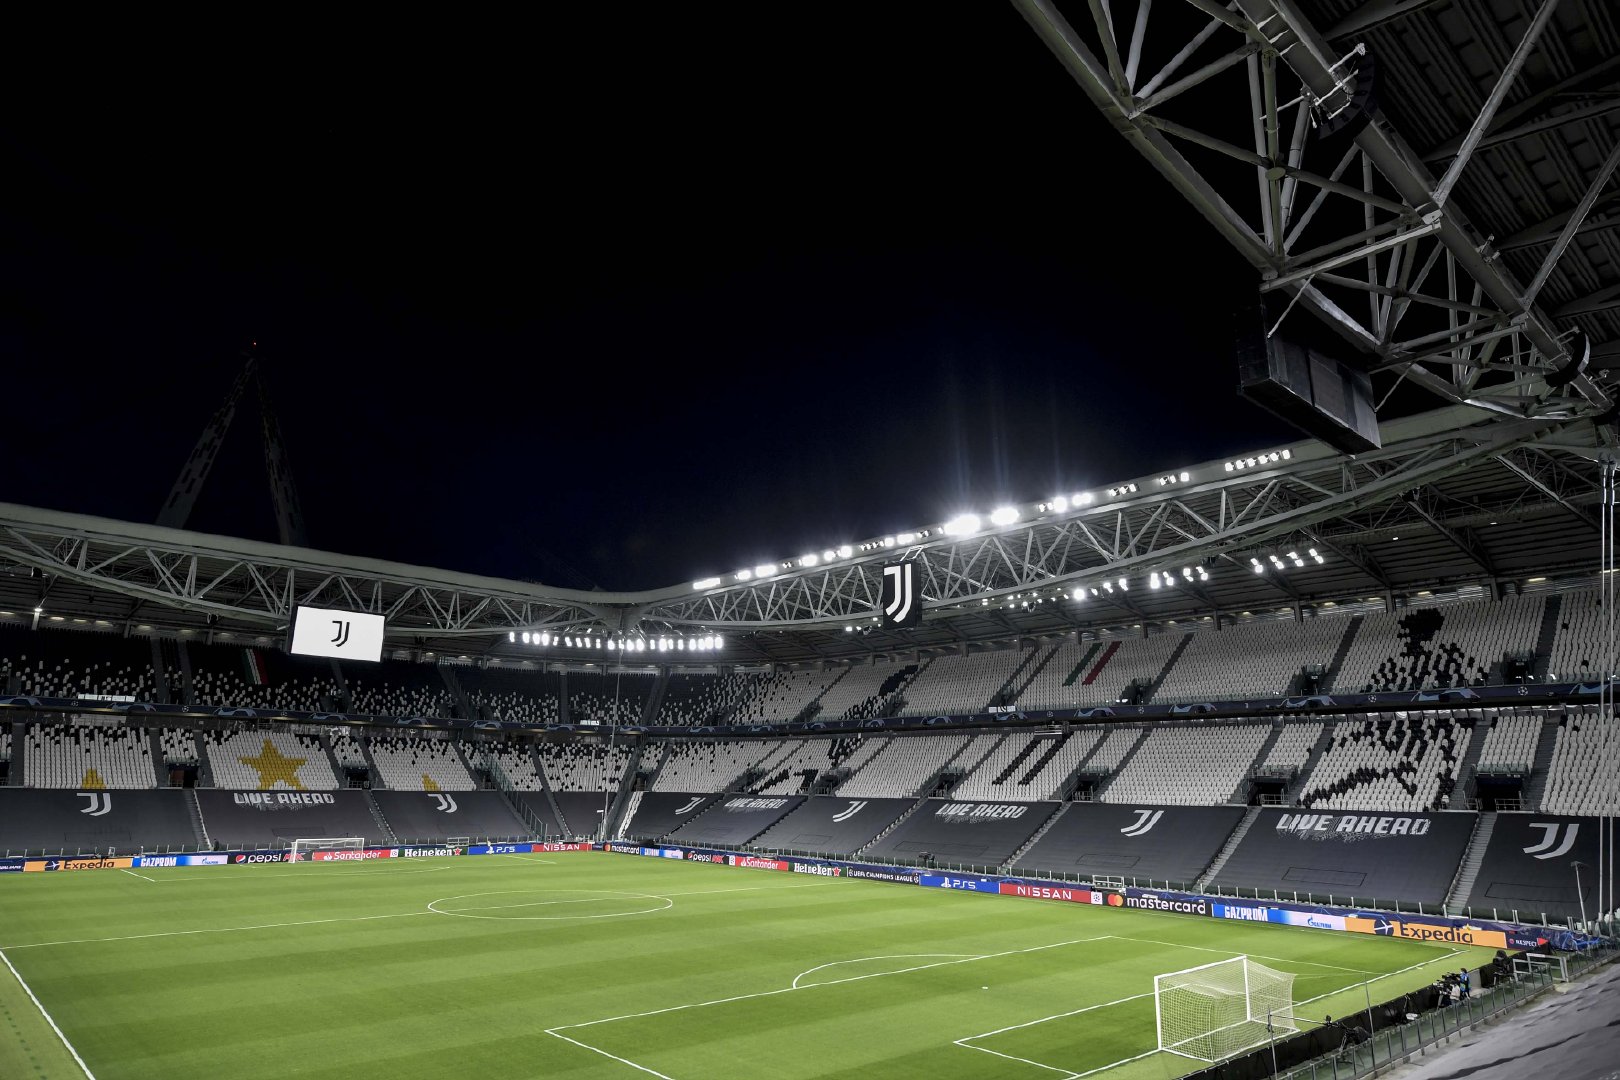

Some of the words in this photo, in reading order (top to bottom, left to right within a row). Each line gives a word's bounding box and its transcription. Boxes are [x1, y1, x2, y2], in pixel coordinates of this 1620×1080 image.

[233, 792, 274, 804] LIVE
[277, 793, 335, 804] AHEAD
[935, 803, 974, 816] LIVE
[969, 804, 1029, 819] AHEAD
[1275, 813, 1334, 832] LIVE
[1335, 815, 1432, 835] AHEAD
[404, 848, 453, 857] Heineken
[543, 844, 580, 852] NISSAN
[611, 844, 640, 855] mastercard
[247, 853, 282, 864] pepsi
[334, 850, 382, 861] Santander
[693, 853, 712, 863] pepsi
[63, 859, 115, 870] Expedia
[140, 856, 178, 867] GAZPROM
[746, 859, 779, 870] Santander
[793, 862, 833, 877] Heineken
[895, 874, 913, 883] LEAGUE
[953, 879, 977, 889] PS5
[1017, 886, 1072, 900] NISSAN
[1126, 896, 1206, 915] mastercard
[1224, 905, 1269, 922] GAZPROM
[1401, 921, 1474, 945] Expedia
